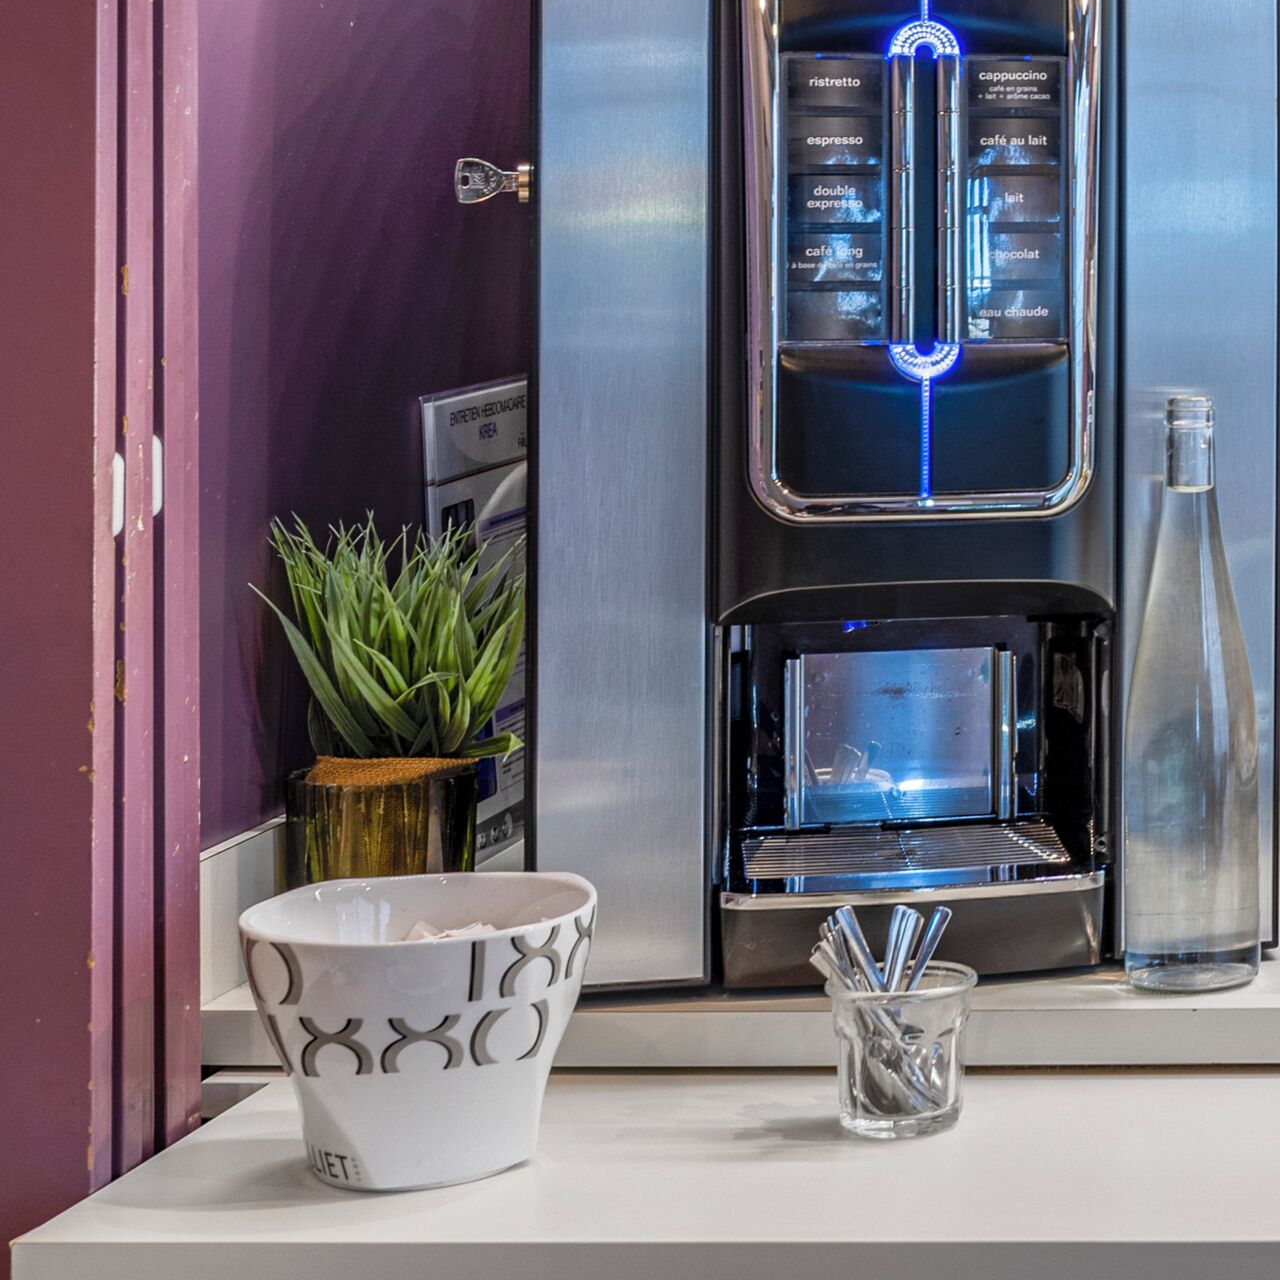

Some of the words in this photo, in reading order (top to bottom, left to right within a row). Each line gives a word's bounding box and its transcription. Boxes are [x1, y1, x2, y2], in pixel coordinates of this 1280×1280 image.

[808, 76, 861, 87] ristretto
[978, 71, 1048, 83] cappuccino
[807, 135, 863, 146] espresso
[980, 134, 1007, 146] café
[1010, 137, 1024, 146] au
[1028, 135, 1048, 146] lait
[813, 185, 856, 197] double
[1004, 192, 1024, 203] lait
[807, 198, 863, 210] expresso
[805, 245, 833, 257] café
[988, 248, 1040, 259] chocolat
[979, 308, 1001, 317] eau
[1004, 306, 1048, 317] chaude
[449, 406, 480, 427] ENTRETIEN
[480, 422, 497, 440] KREA
